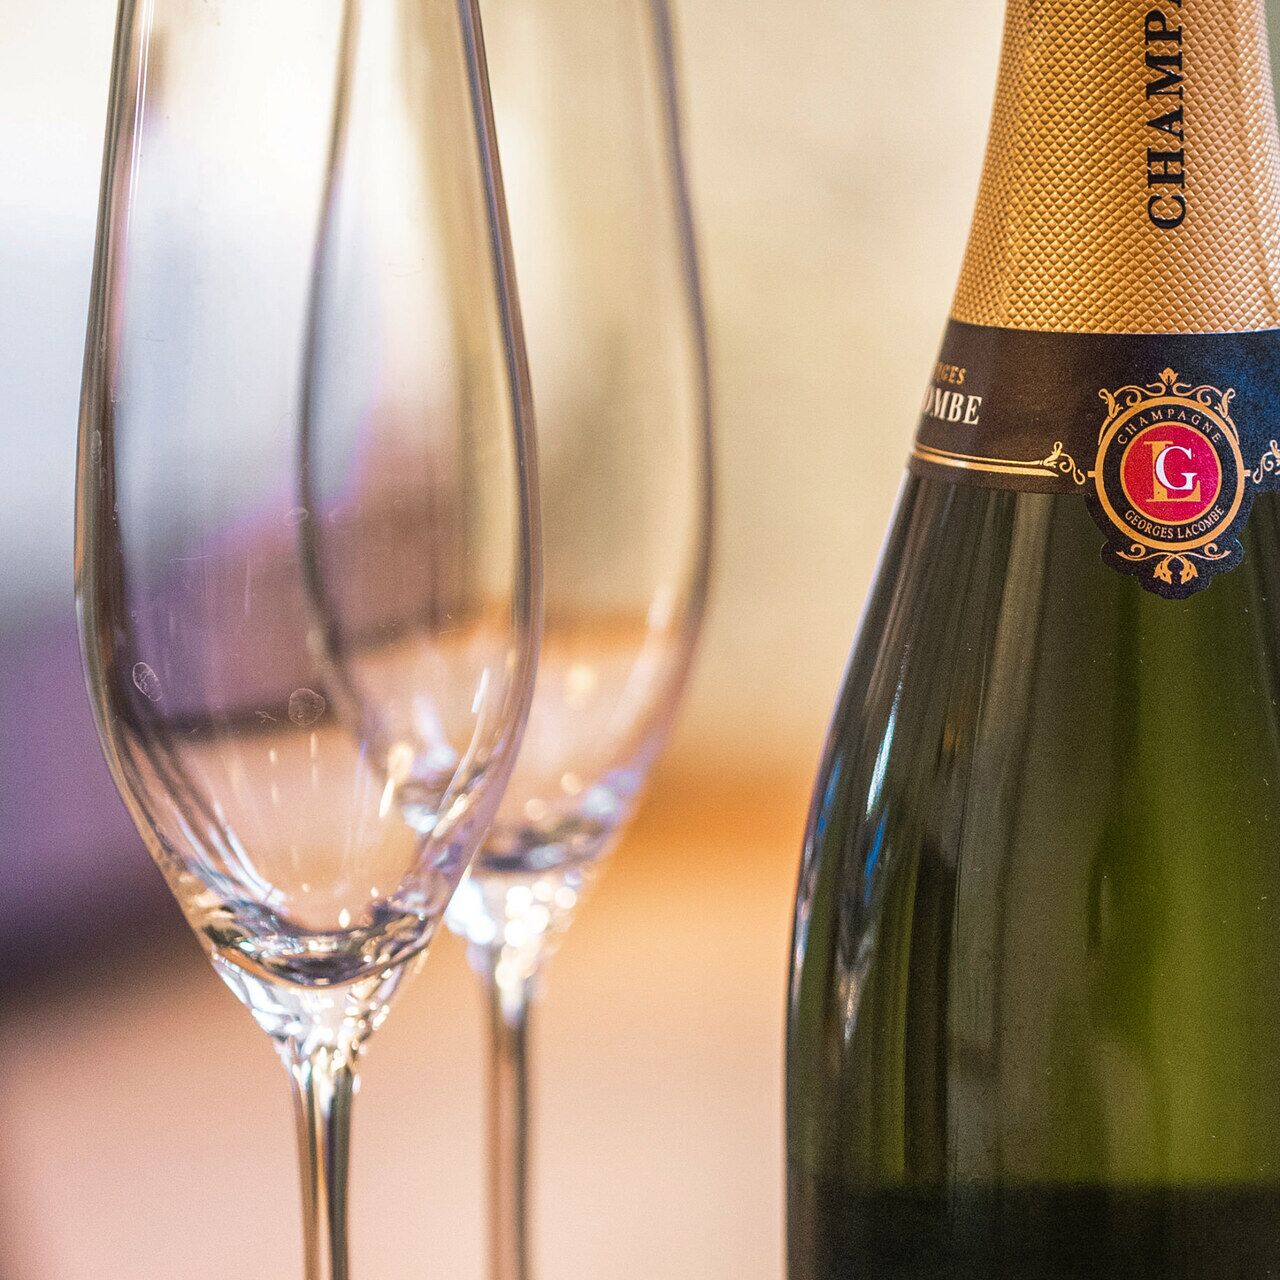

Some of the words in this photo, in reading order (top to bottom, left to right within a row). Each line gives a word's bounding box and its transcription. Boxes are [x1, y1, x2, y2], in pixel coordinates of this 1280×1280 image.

[1117, 408, 1222, 446] CHAMPAGNE
[1125, 509, 1174, 539] GEORGES
[1177, 504, 1225, 540] LACOMBE
